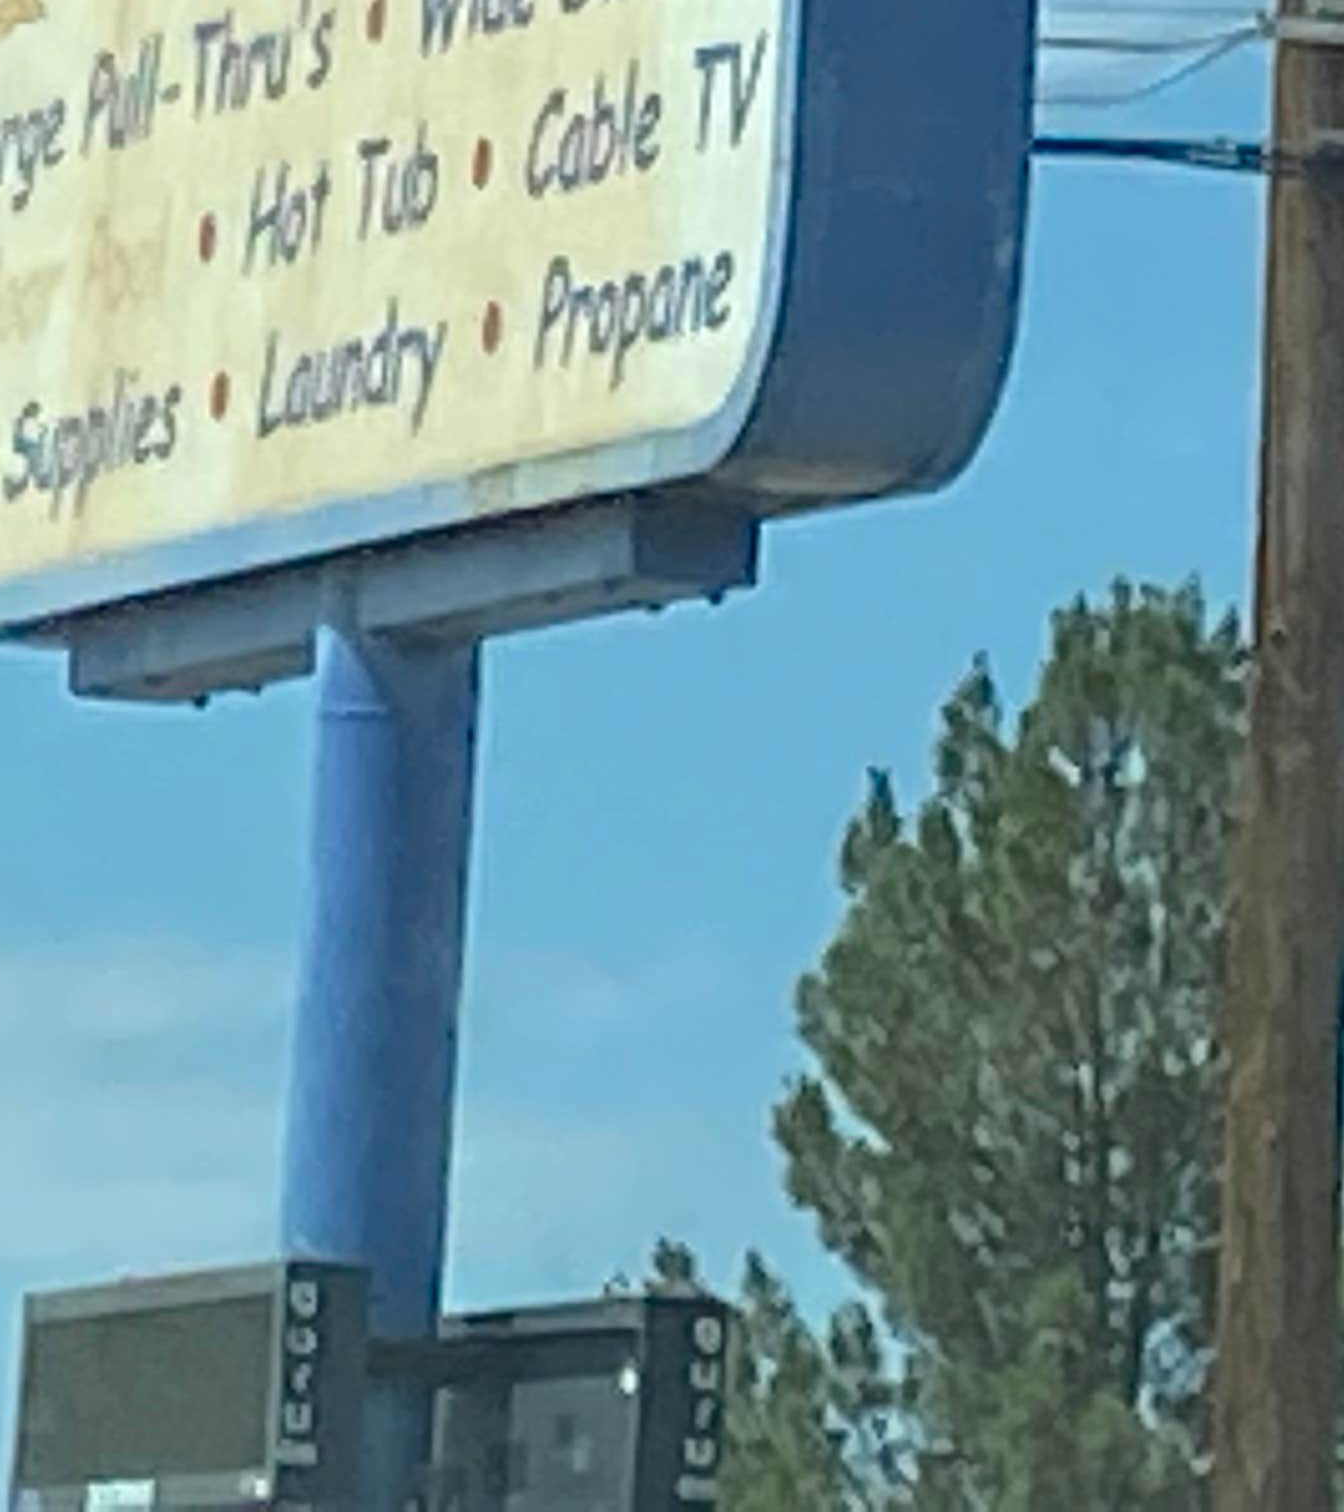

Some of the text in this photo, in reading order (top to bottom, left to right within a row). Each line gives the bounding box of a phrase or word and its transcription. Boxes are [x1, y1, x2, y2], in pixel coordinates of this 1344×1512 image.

[241, 156, 332, 277] Hot
[355, 118, 439, 242] Tub
[525, 54, 662, 200] Cable
[692, 27, 770, 154] TV
[2, 365, 183, 522] Supplies
[256, 294, 449, 439] Laundry
[532, 248, 735, 390] Propane
